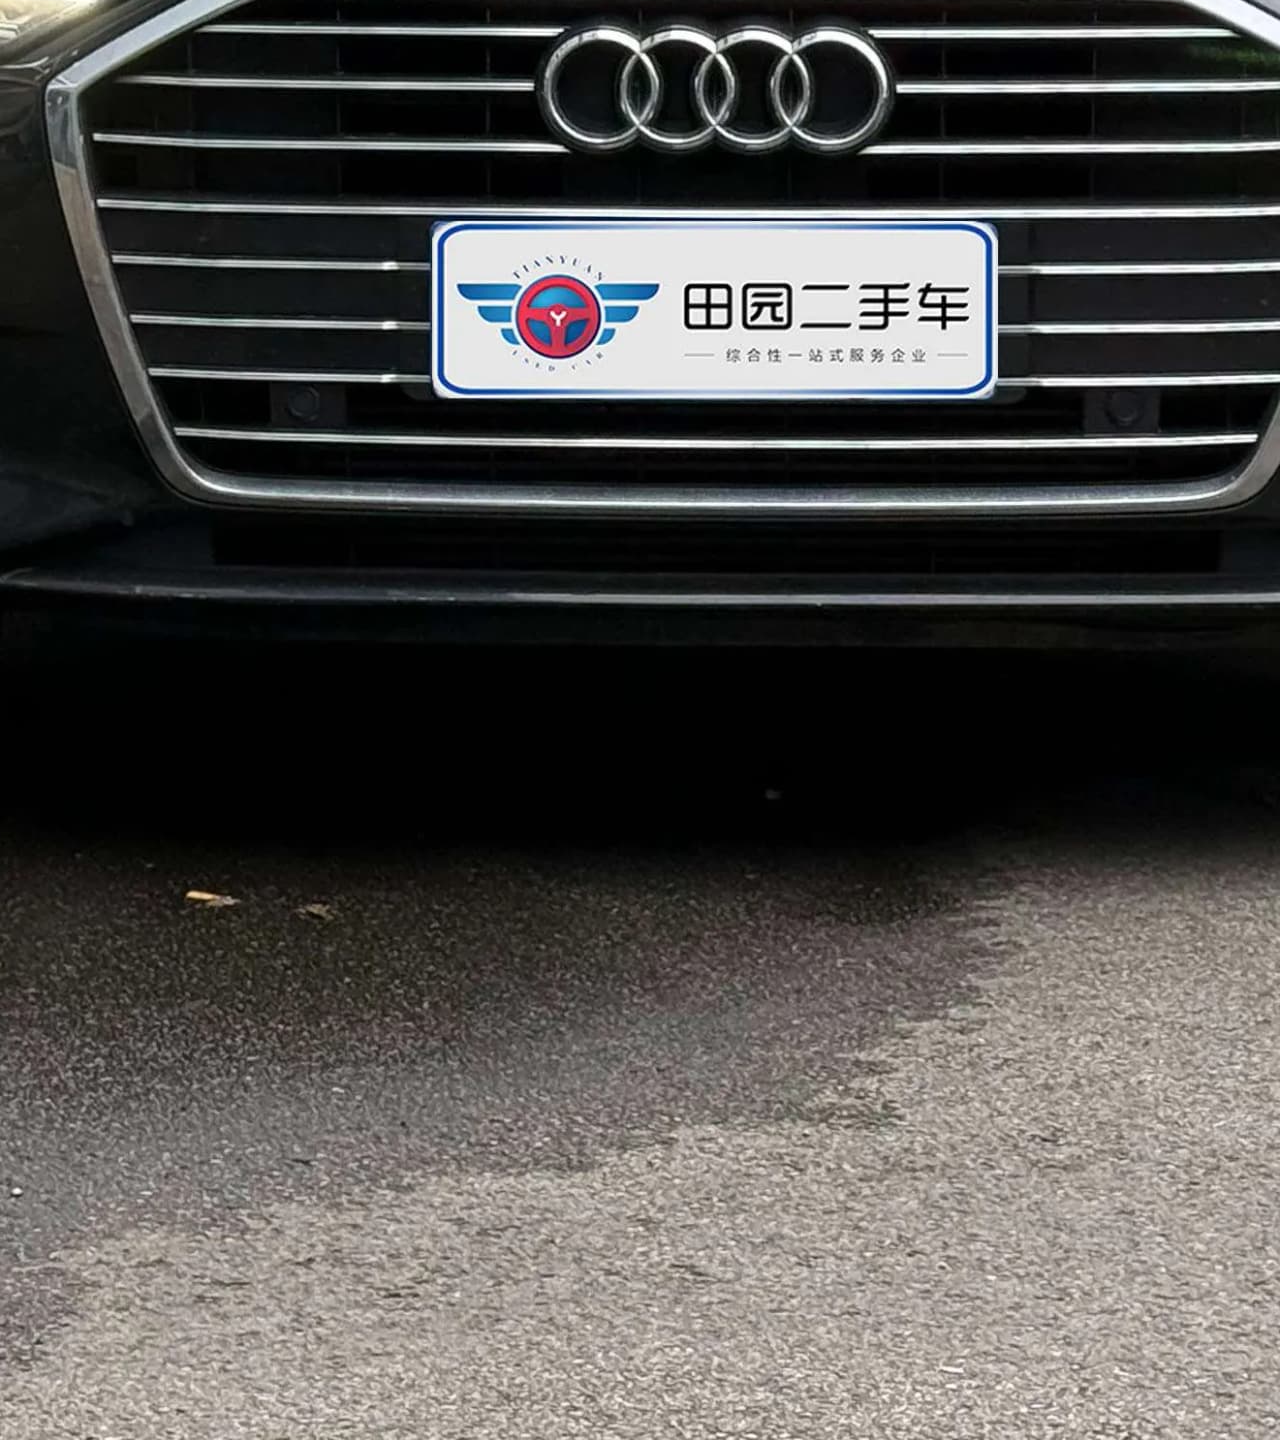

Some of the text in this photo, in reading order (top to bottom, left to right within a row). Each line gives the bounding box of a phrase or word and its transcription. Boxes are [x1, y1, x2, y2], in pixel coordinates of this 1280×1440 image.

[683, 282, 970, 331] 田园二手车
[725, 347, 927, 364] 综合性一站式服务企业
